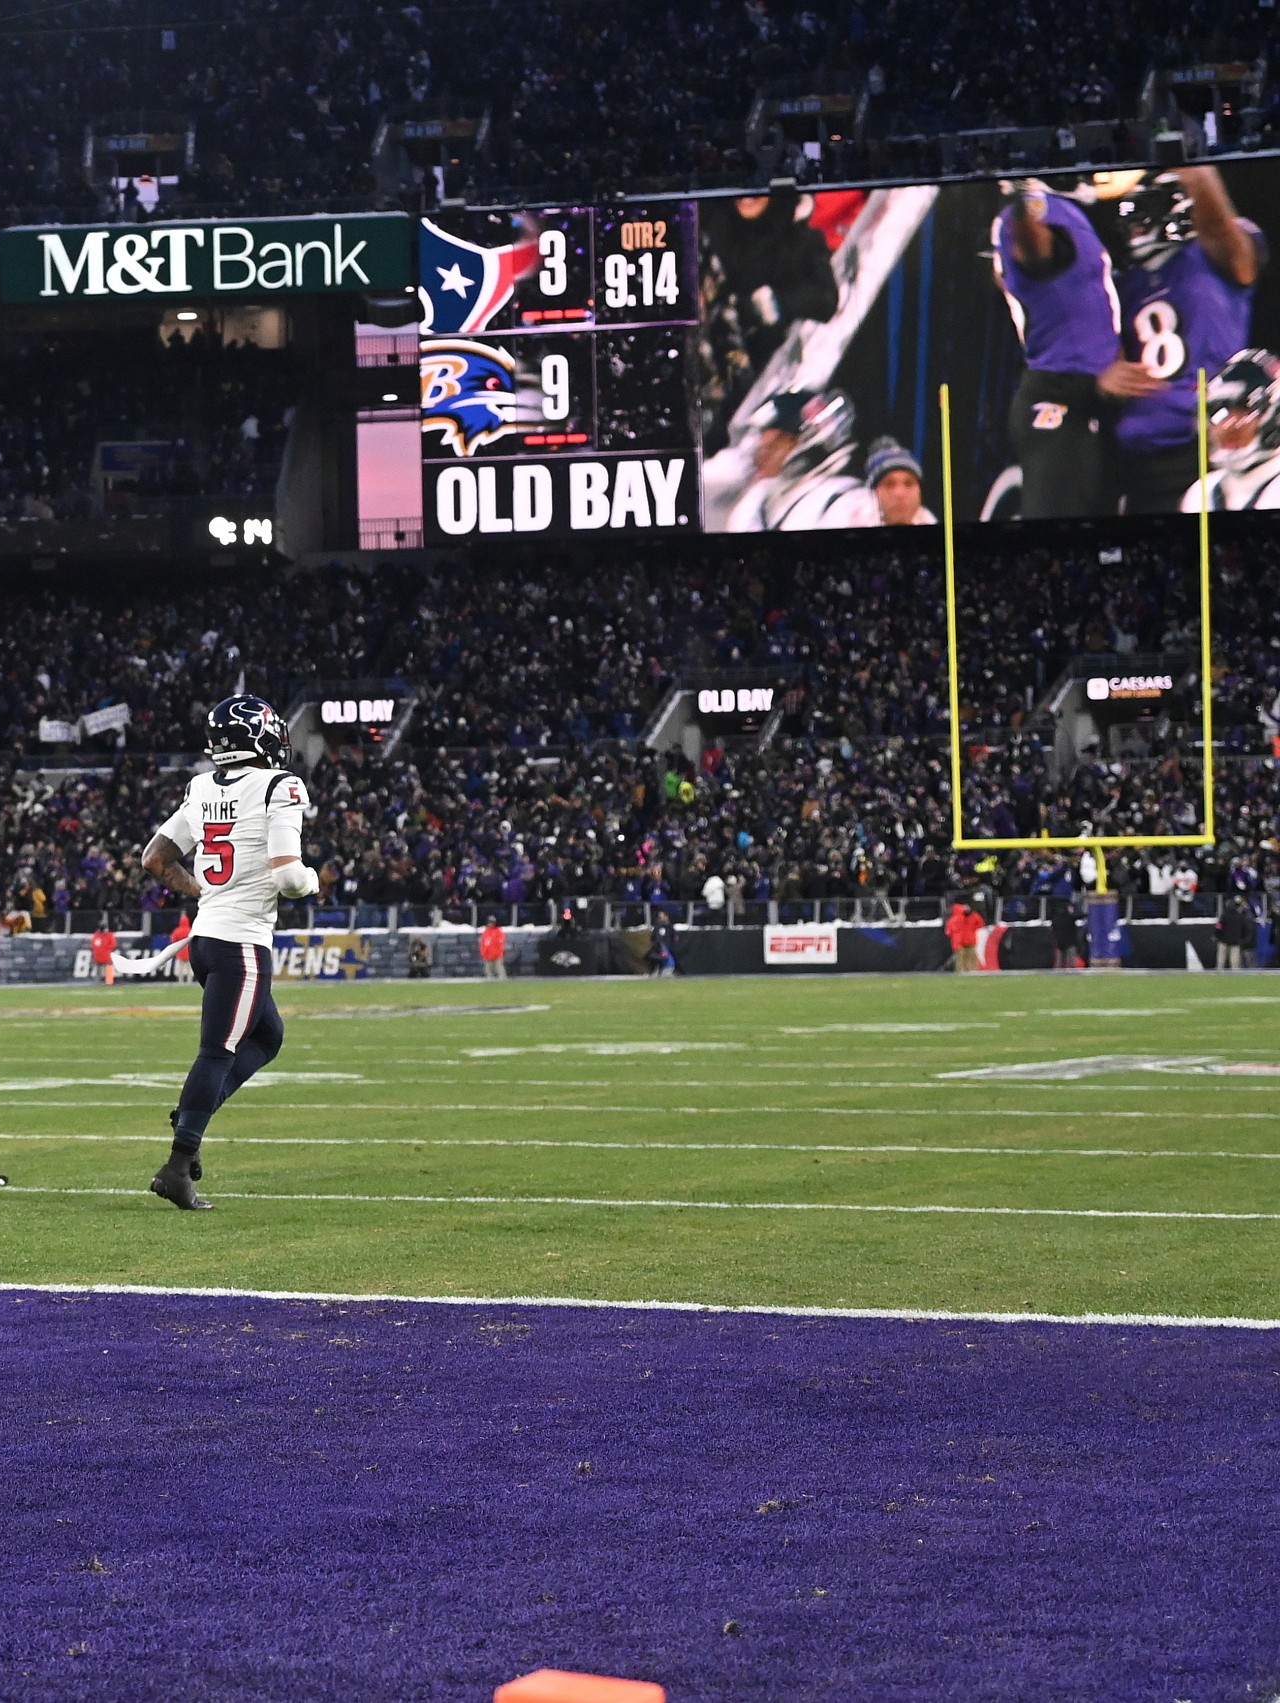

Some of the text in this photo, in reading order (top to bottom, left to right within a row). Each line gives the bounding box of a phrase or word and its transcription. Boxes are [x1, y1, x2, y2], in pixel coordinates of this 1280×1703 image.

[38, 223, 370, 296] M&T Bank
[538, 230, 567, 296] 3
[604, 251, 679, 308] 9:14
[1133, 300, 1186, 379] 8
[541, 354, 569, 420] 9
[436, 464, 553, 535] OLD
[698, 688, 774, 713] OLD BAY
[1108, 675, 1172, 691] CAESARS
[321, 699, 395, 724] OLD BAY
[201, 800, 239, 820] PITRE
[288, 787, 301, 804] 5
[200, 822, 237, 885] 5
[272, 947, 341, 976] VENS
[769, 936, 832, 953] ESPN
